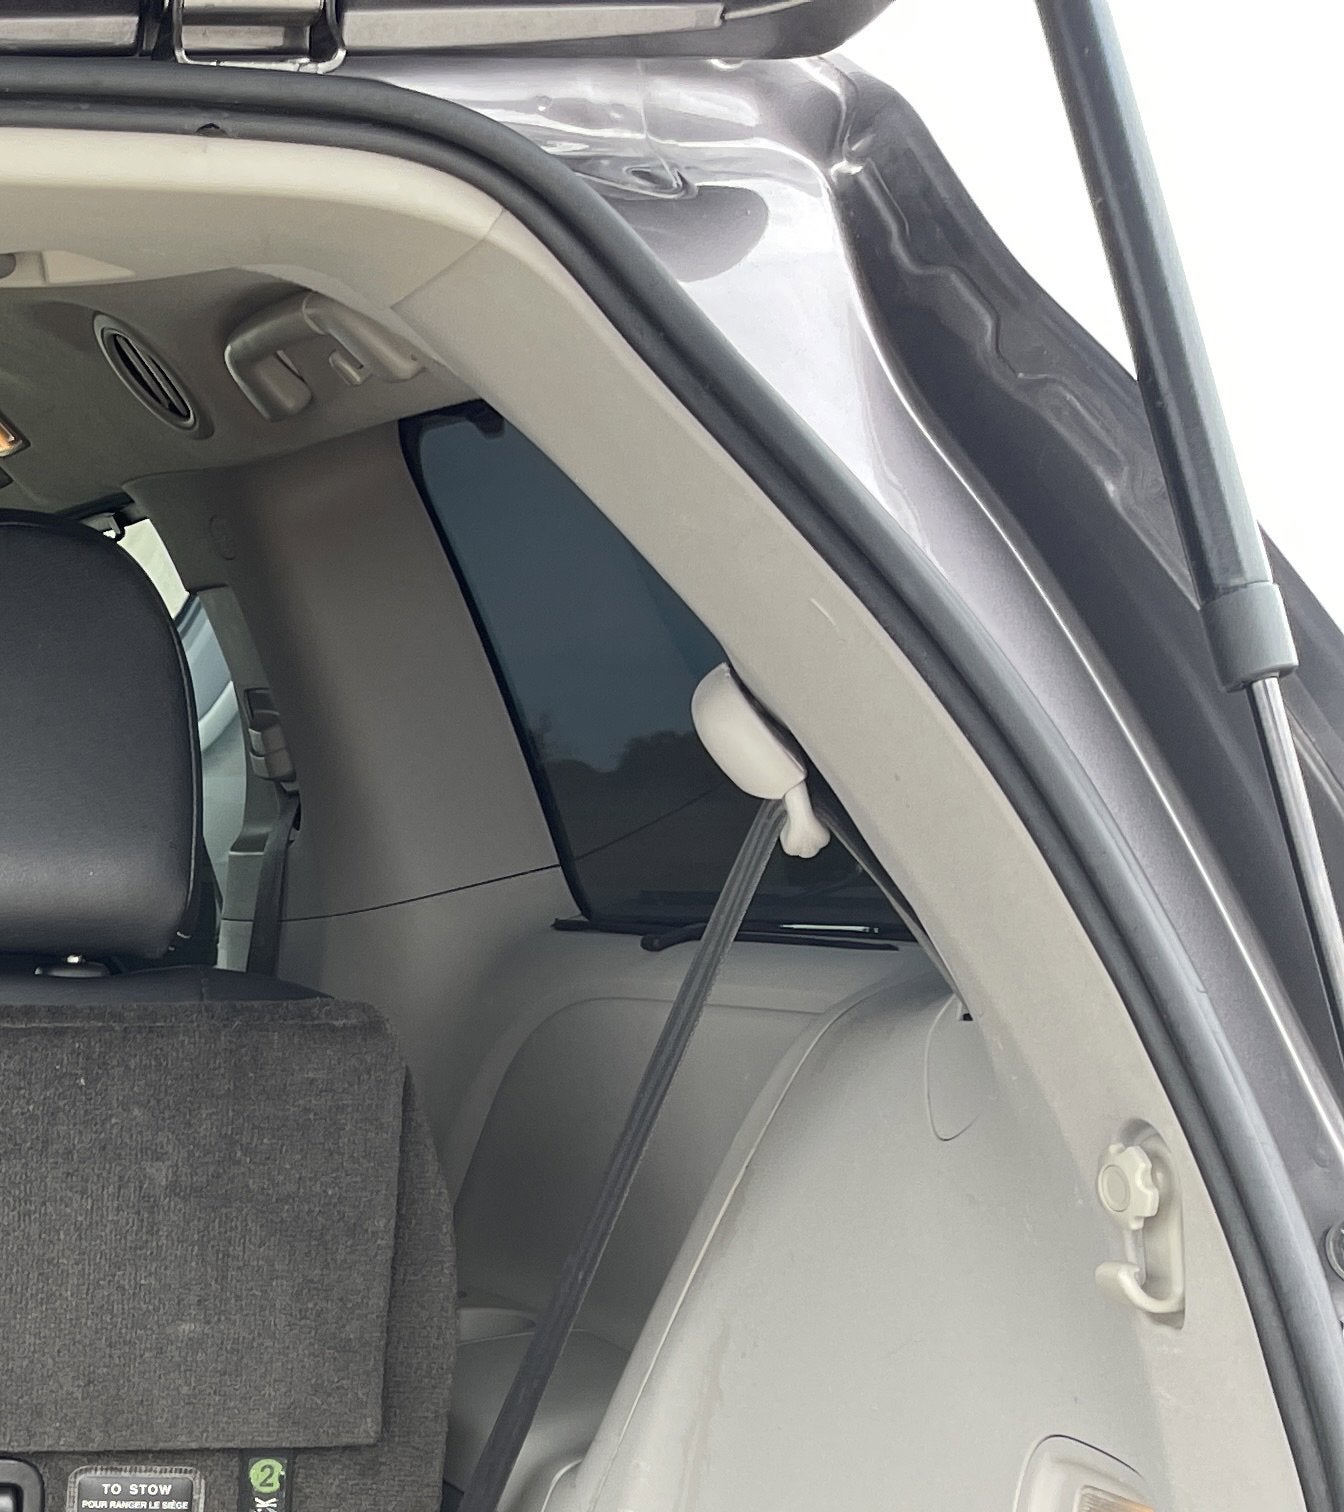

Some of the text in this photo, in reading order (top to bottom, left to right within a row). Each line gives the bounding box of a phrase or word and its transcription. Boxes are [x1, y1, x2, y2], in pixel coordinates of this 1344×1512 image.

[259, 1464, 274, 1487] 2
[102, 1484, 172, 1495] TO STOW
[82, 1500, 107, 1509] POUR
[109, 1500, 147, 1509] RANGER
[149, 1501, 159, 1509] LE
